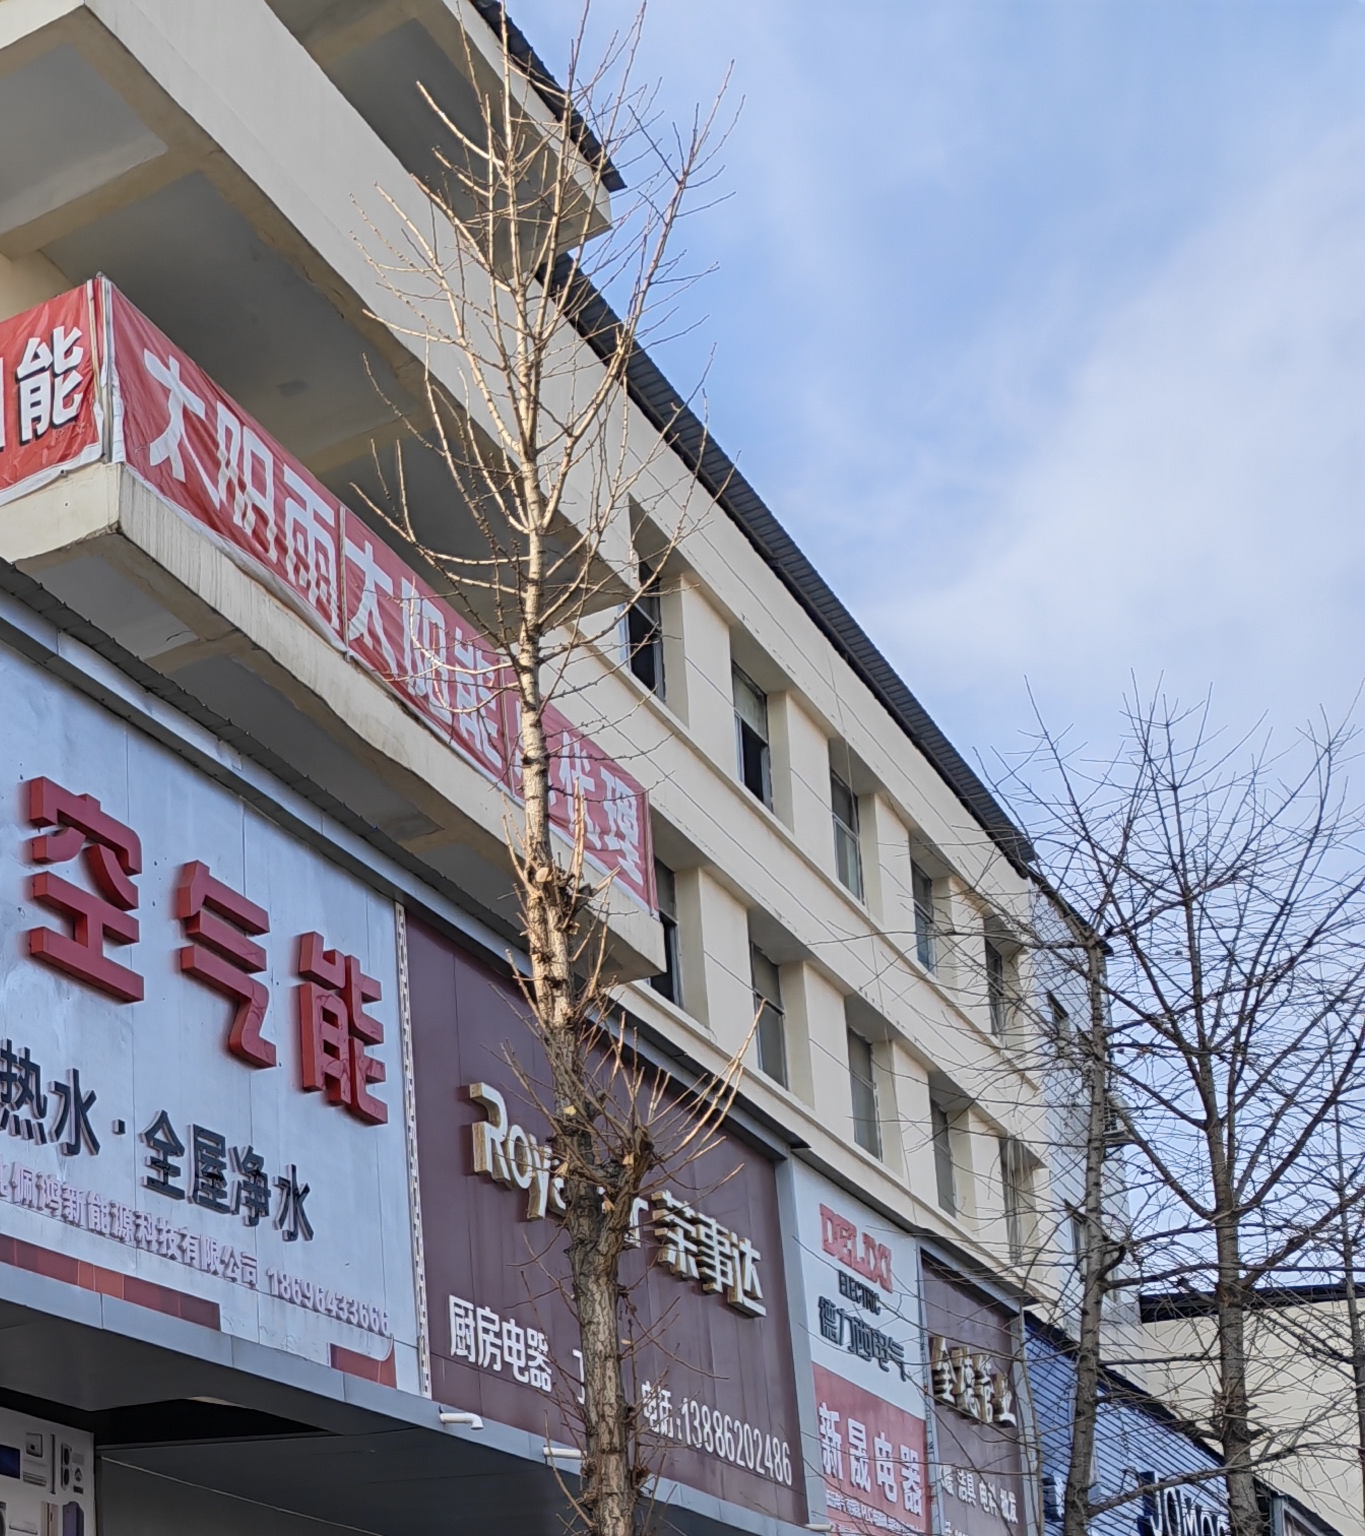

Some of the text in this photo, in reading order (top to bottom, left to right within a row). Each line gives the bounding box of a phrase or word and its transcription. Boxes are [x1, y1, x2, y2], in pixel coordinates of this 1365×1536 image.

[143, 345, 644, 886] 太阳雨太阳能代理
[654, 1188, 767, 1318] 荣事达
[819, 1204, 893, 1293] DELIXI
[449, 1293, 553, 1394] 厨房电器
